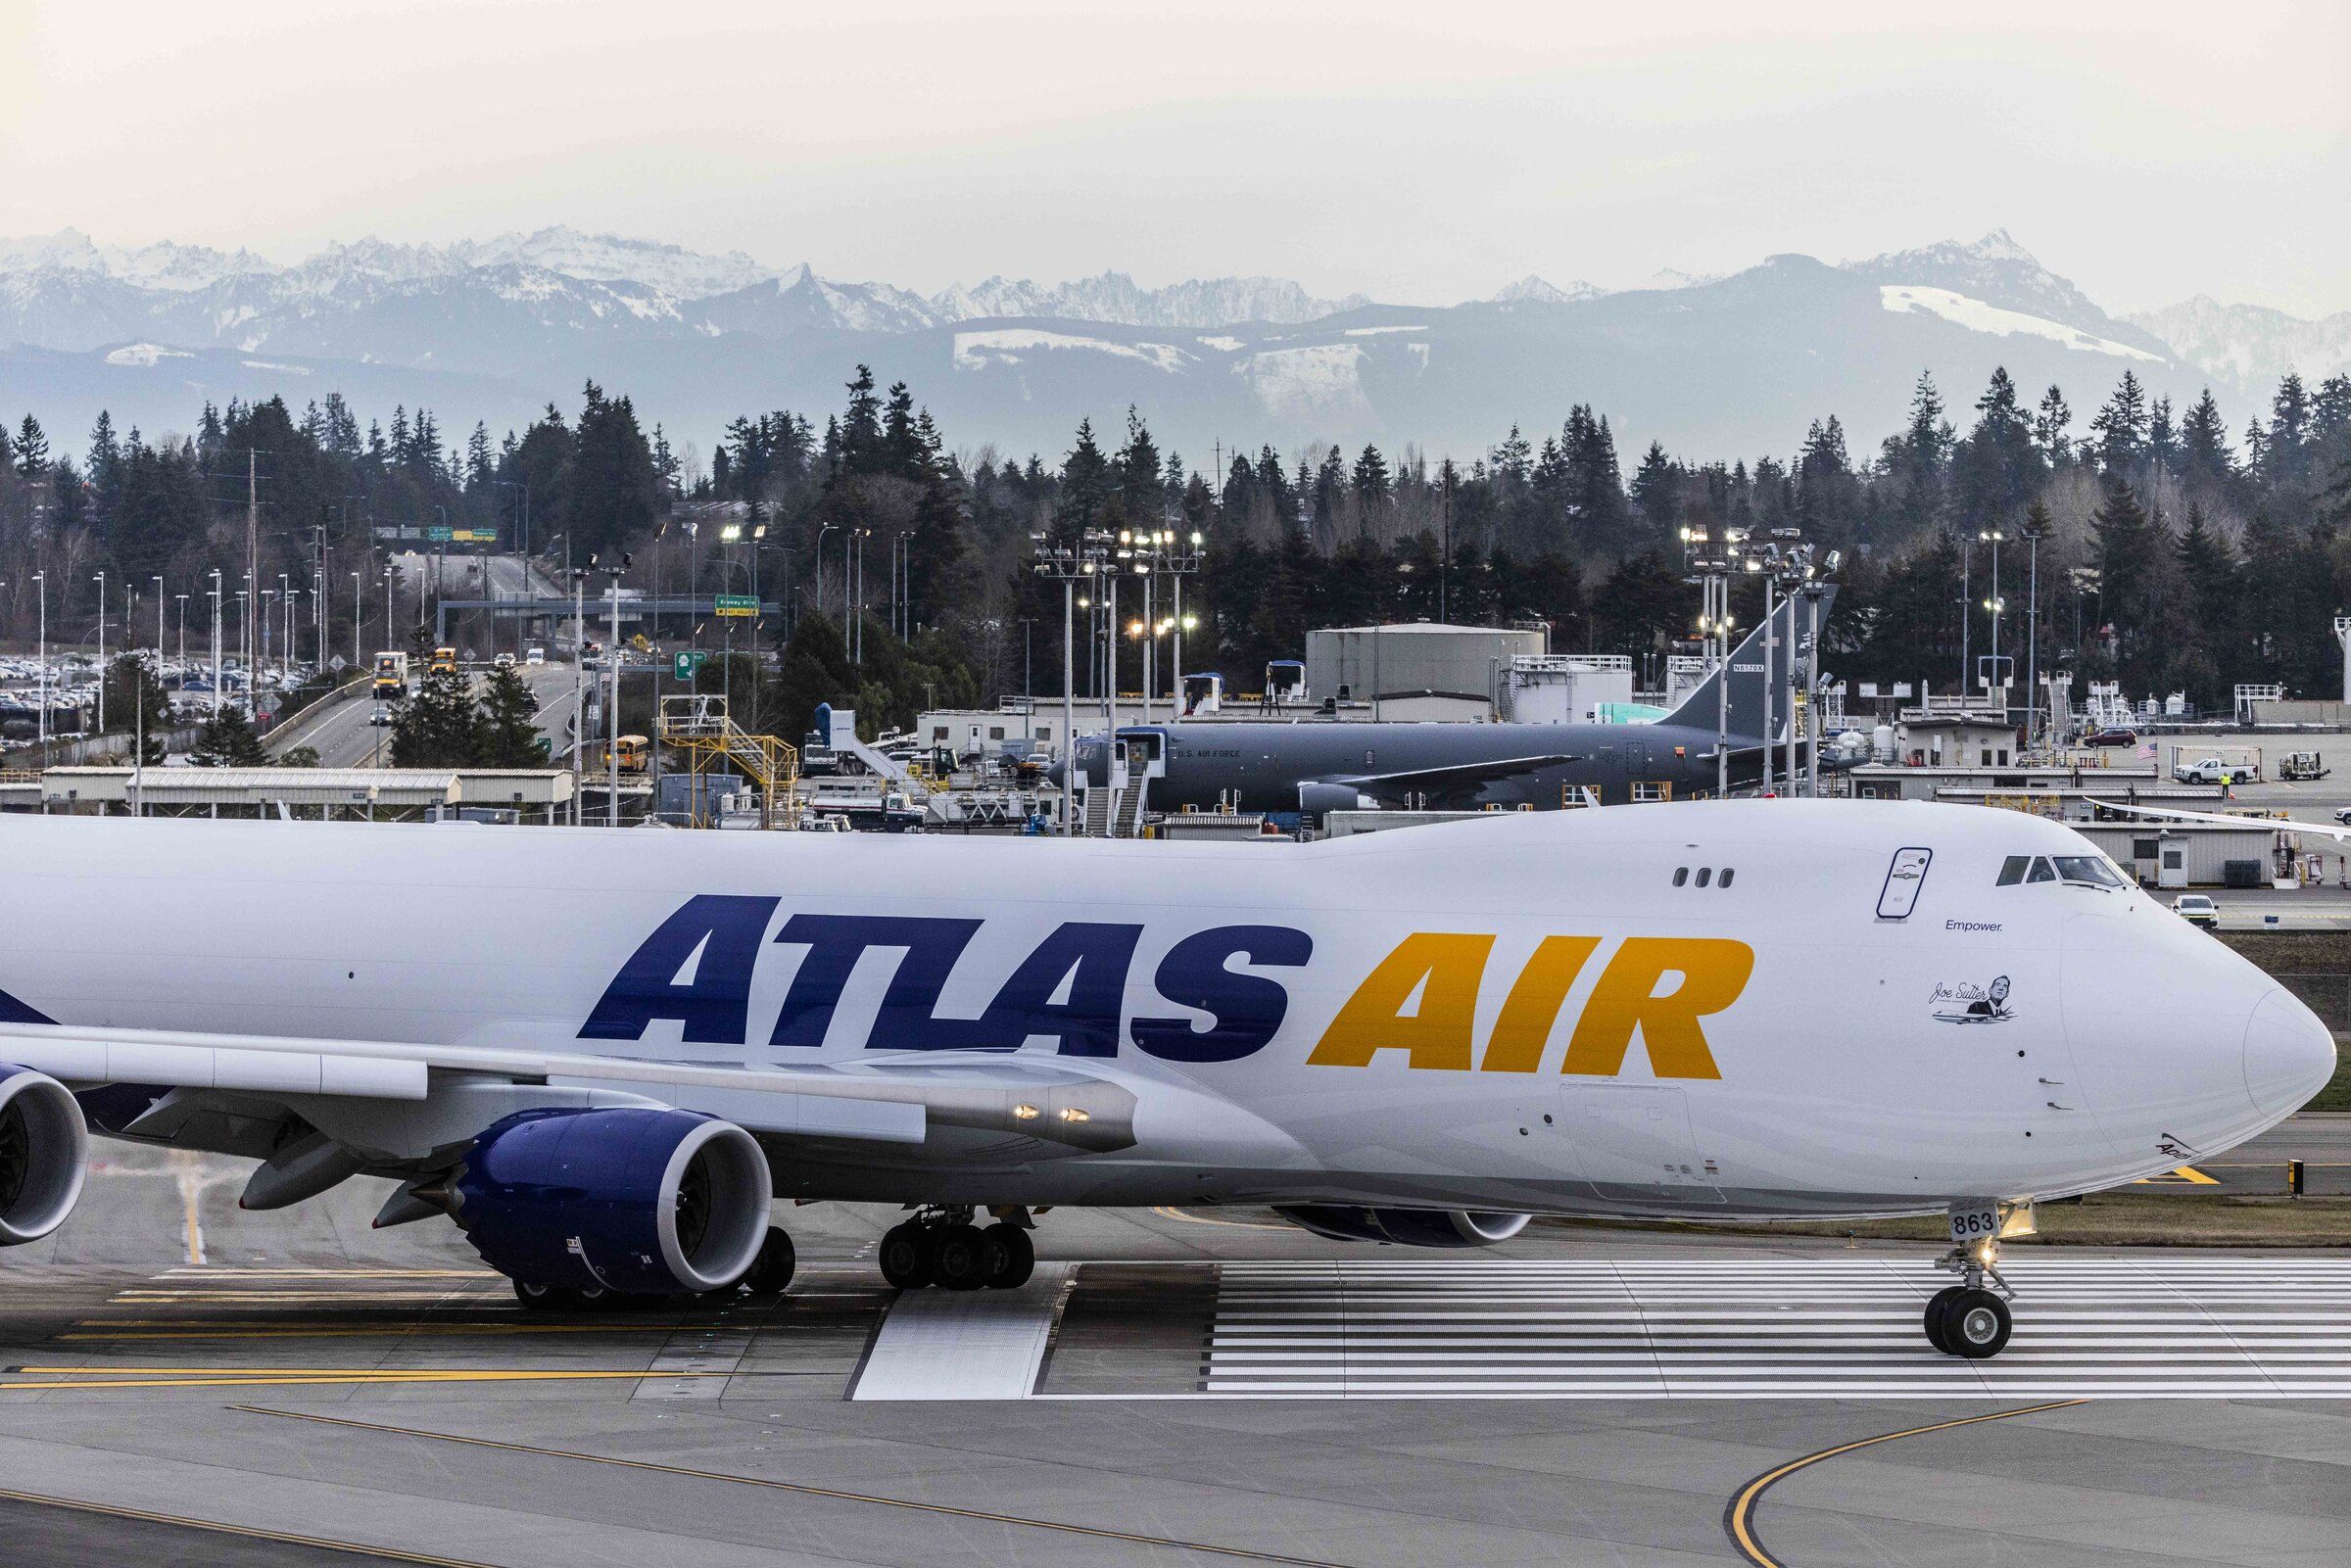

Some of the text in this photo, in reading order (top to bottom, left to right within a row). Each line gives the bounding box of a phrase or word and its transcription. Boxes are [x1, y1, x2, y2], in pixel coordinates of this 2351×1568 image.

[1945, 920, 2003, 932] Empower.
[576, 894, 1755, 1080] ATLAS AIR
[1929, 982, 1987, 1004] Joe Sutter
[1953, 1212, 1994, 1235] 863
